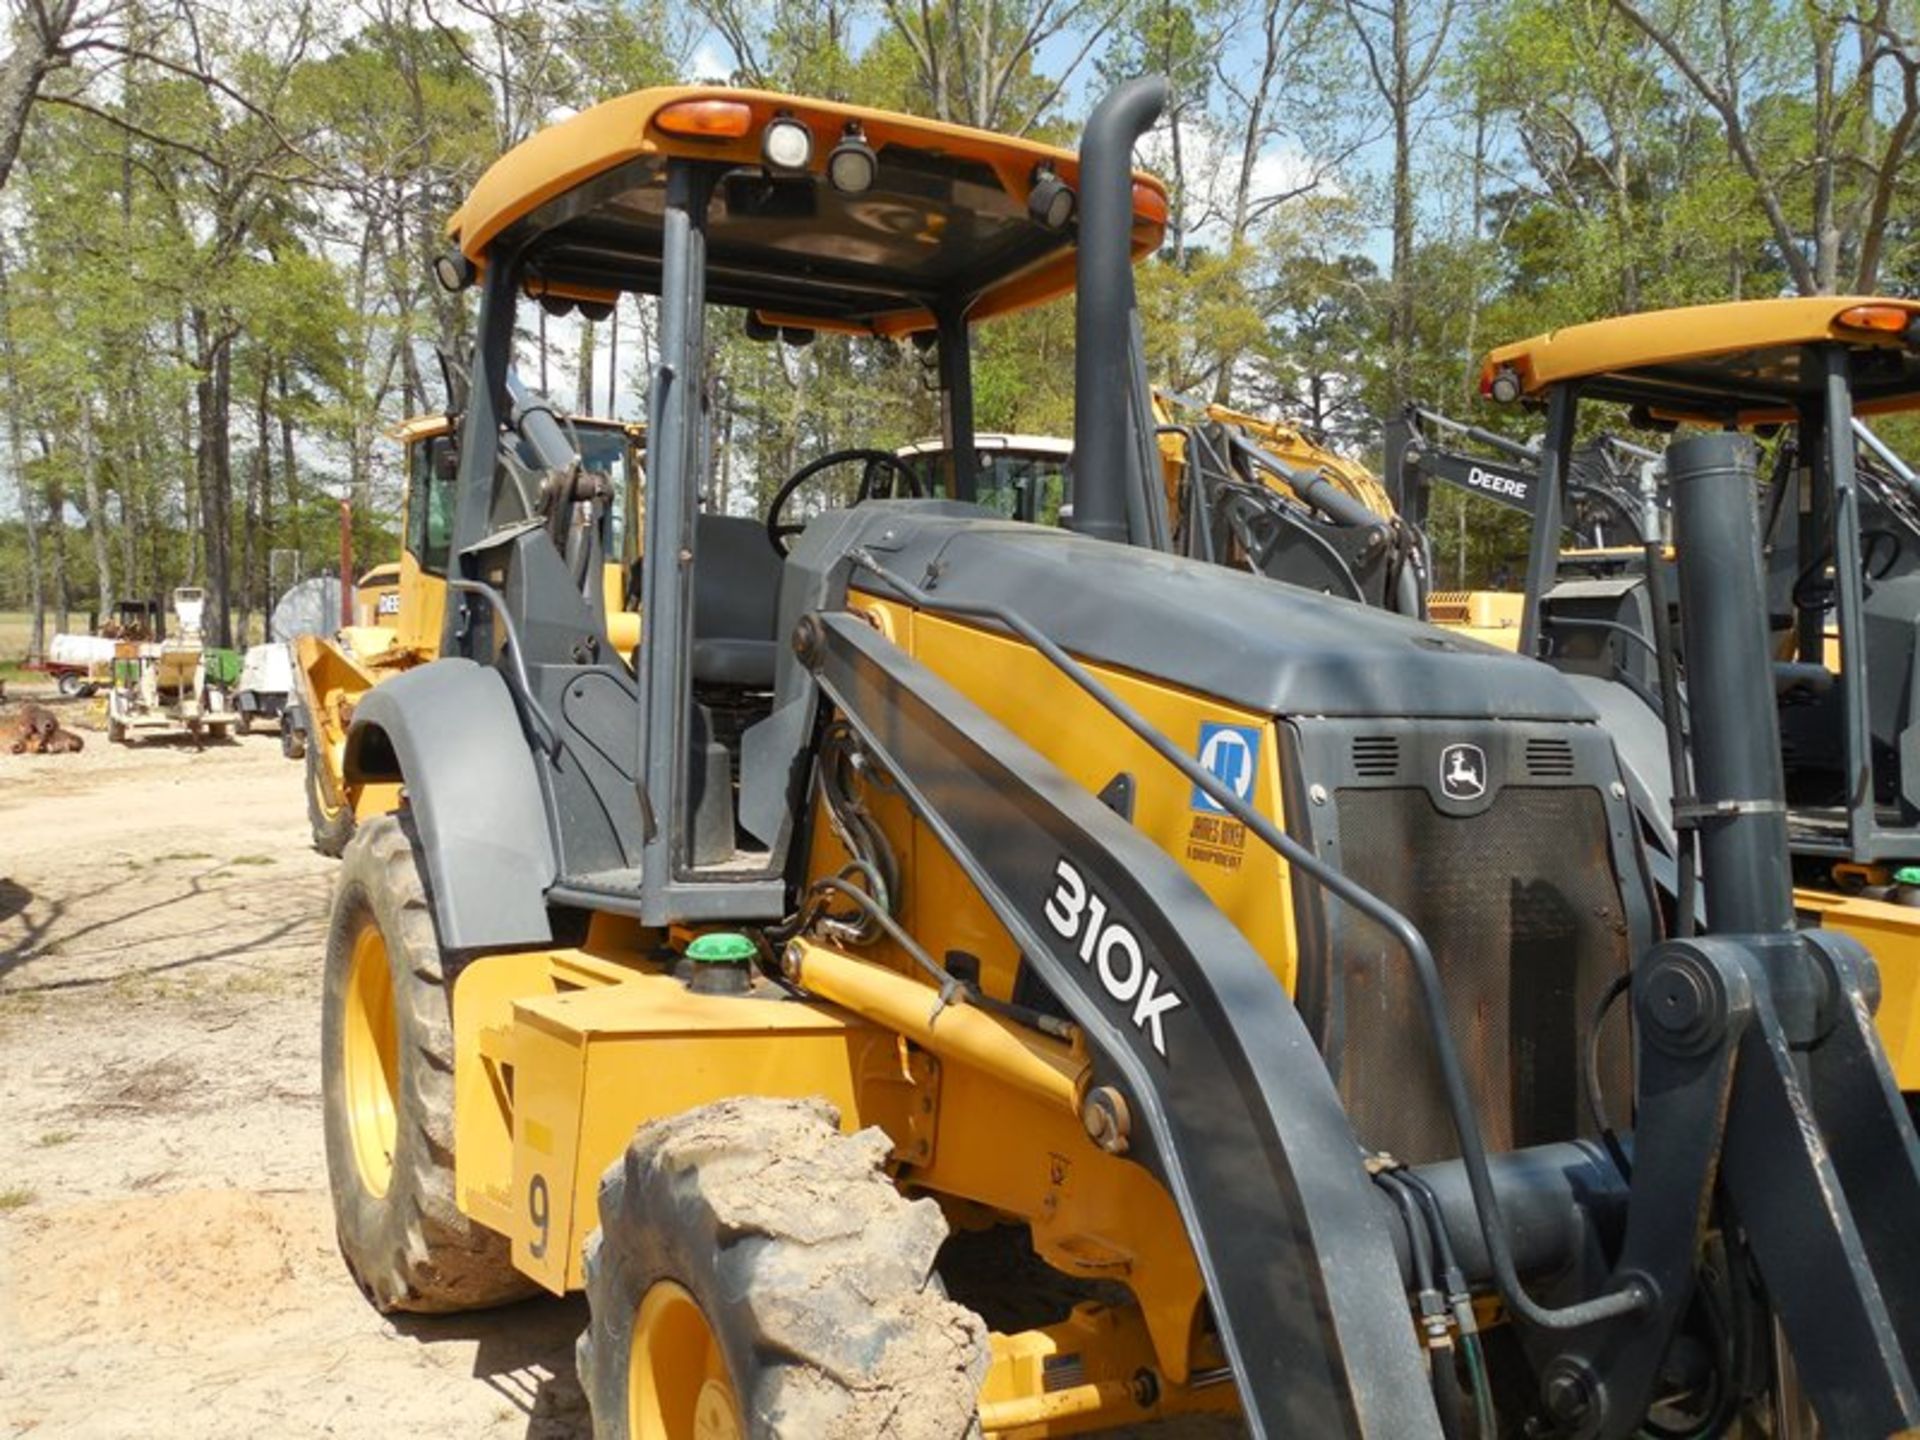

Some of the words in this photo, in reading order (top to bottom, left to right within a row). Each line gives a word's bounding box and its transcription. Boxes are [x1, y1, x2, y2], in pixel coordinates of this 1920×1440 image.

[1468, 466, 1528, 499] DEERE
[1045, 860, 1181, 1056] 310K
[529, 1173, 549, 1260] 9
